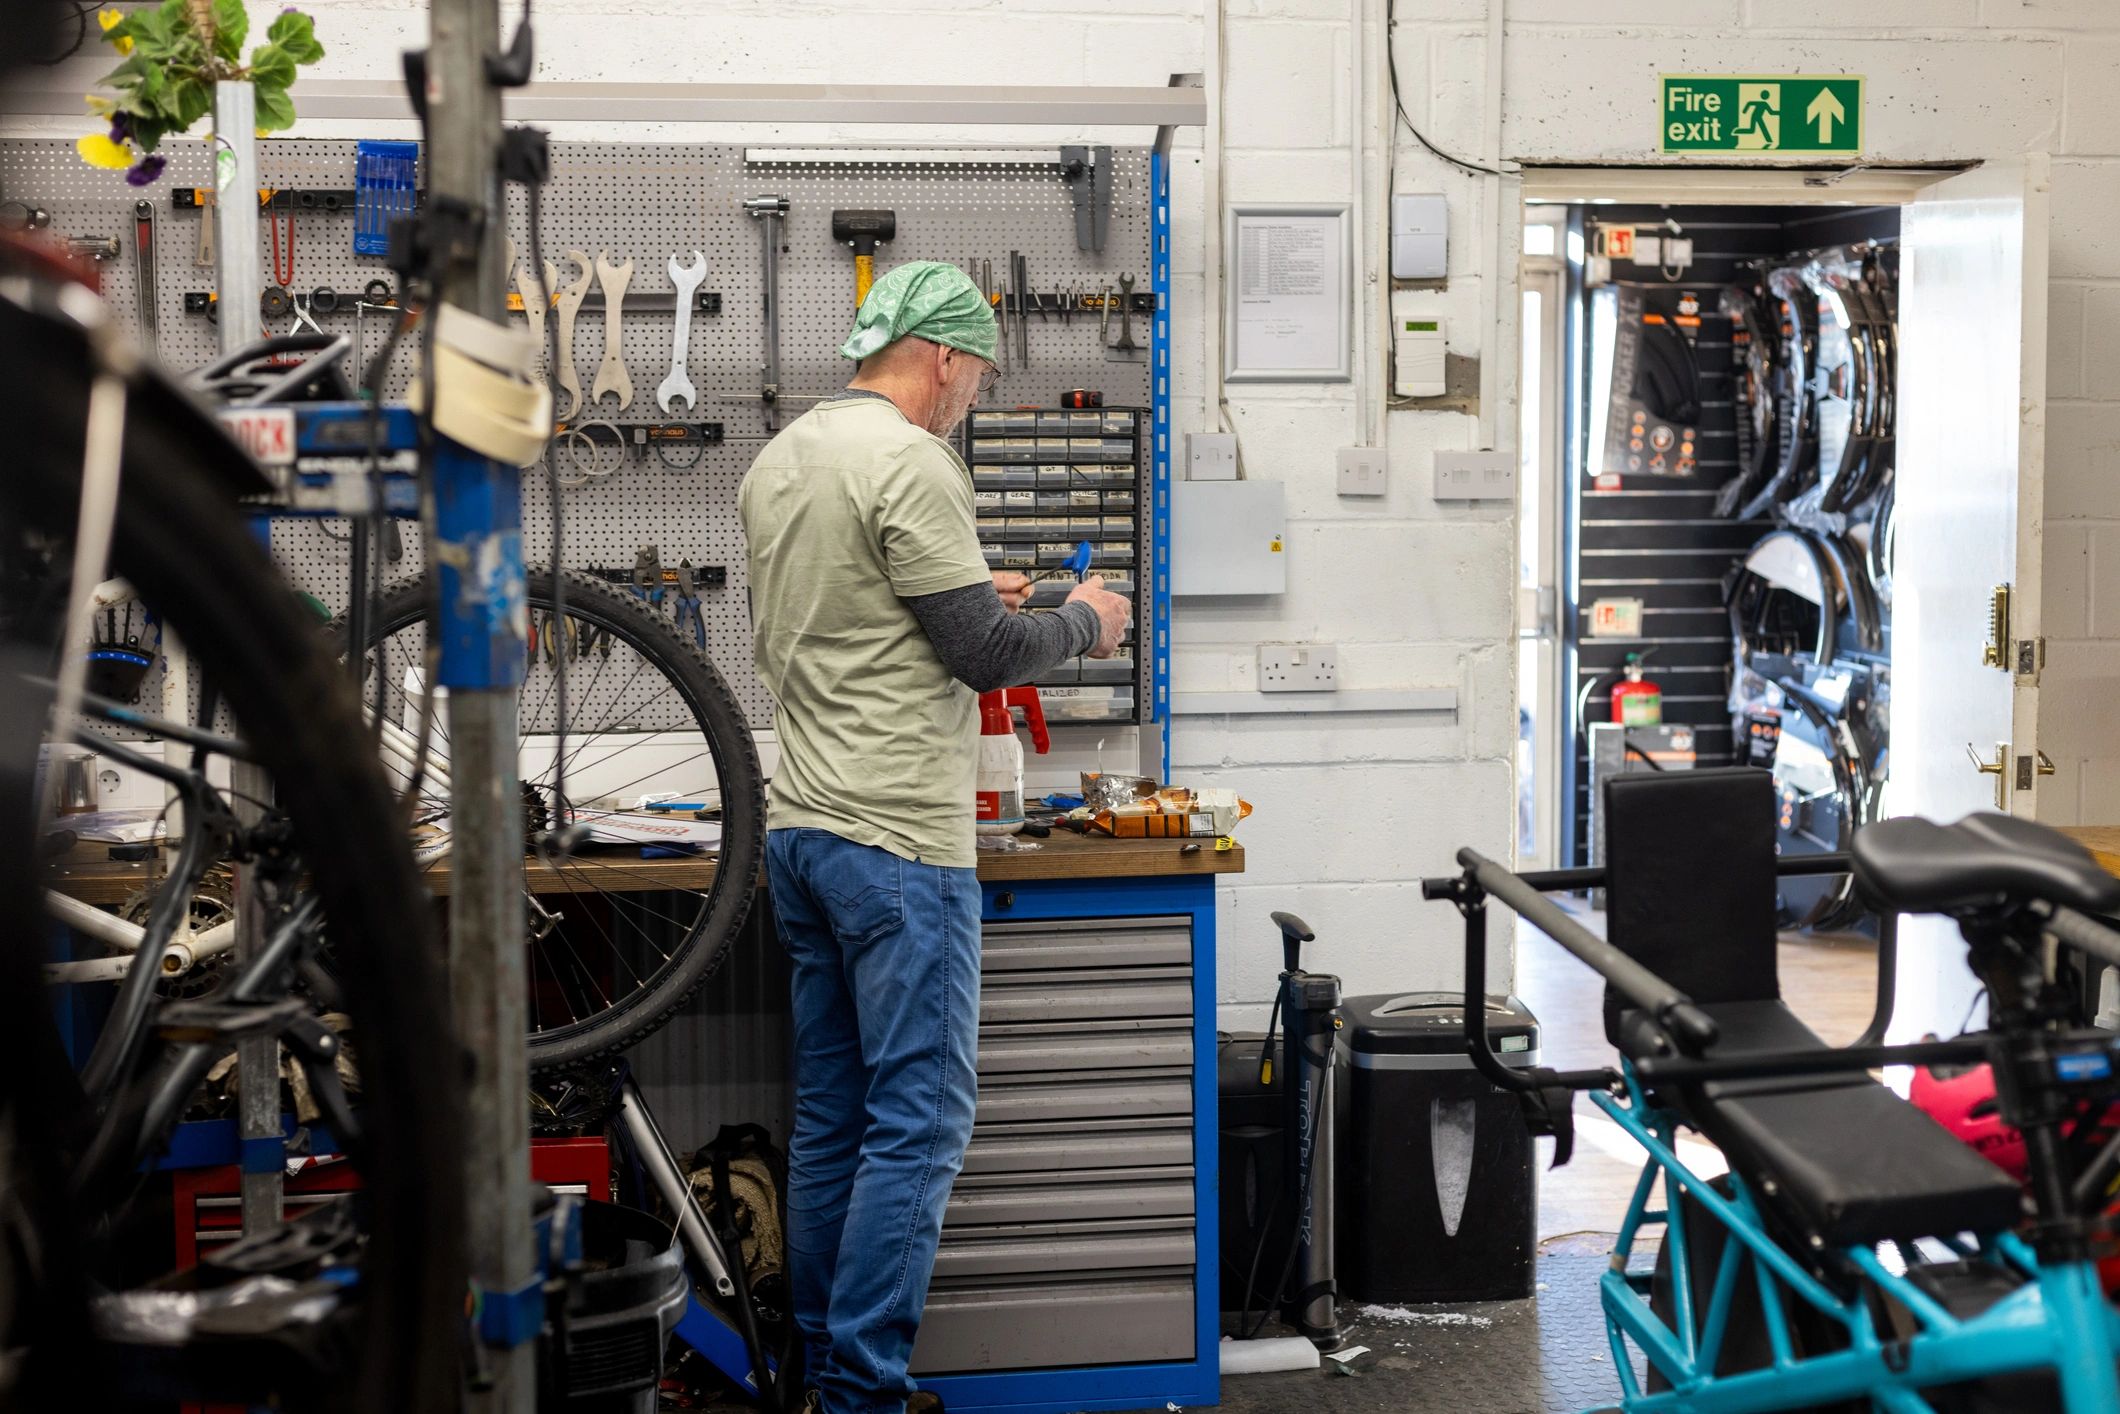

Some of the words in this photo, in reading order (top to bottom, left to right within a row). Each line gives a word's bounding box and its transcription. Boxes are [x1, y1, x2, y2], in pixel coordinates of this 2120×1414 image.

[1668, 87, 1722, 112] Fire
[1668, 117, 1722, 142] exit
[224, 418, 289, 456] OCK
